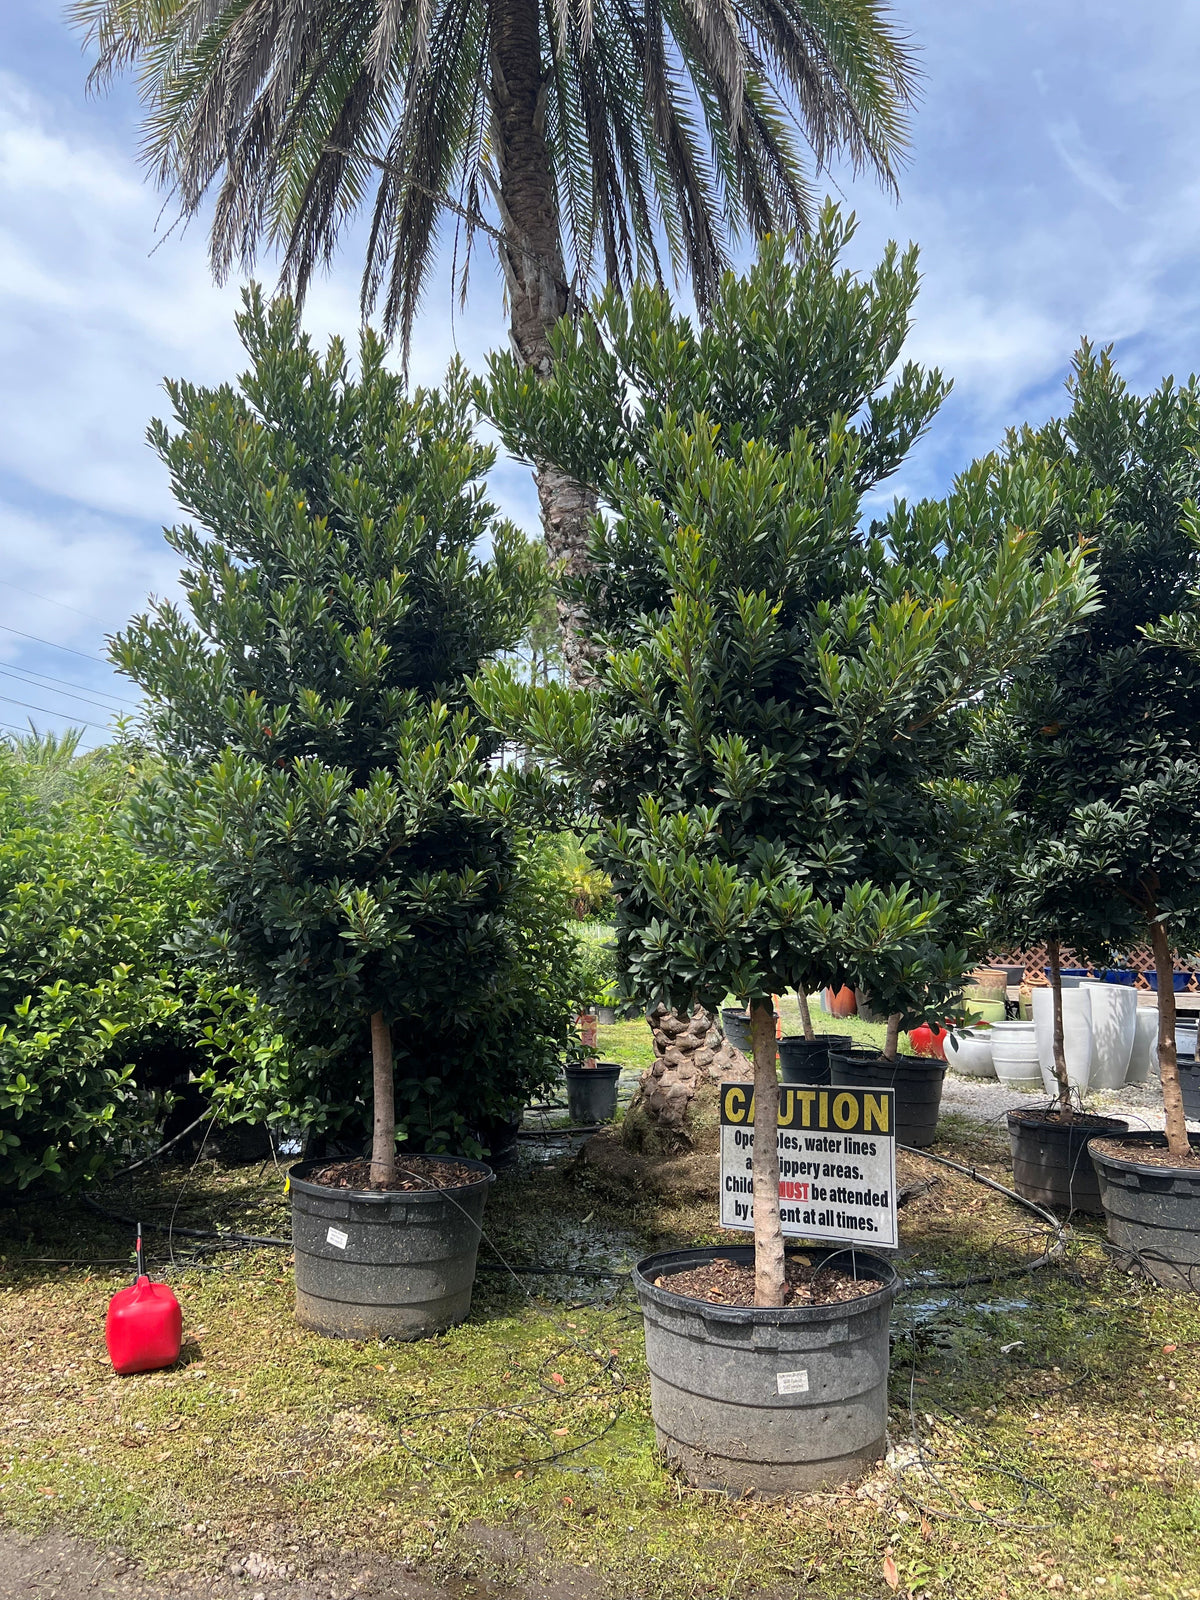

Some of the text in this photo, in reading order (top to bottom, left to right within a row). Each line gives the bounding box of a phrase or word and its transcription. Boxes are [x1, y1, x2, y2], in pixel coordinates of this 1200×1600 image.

[725, 1087, 889, 1132] CUTION
[735, 1130, 755, 1149] Ope
[804, 1137, 841, 1153] water
[844, 1137, 876, 1156] lines
[778, 1156, 863, 1180] ippery areas.
[725, 1175, 754, 1195] Child
[811, 1183, 827, 1201] be
[829, 1187, 888, 1208] attended
[735, 1199, 748, 1221] by
[803, 1209, 816, 1225] at
[818, 1209, 834, 1227] all
[836, 1211, 878, 1232] times.
